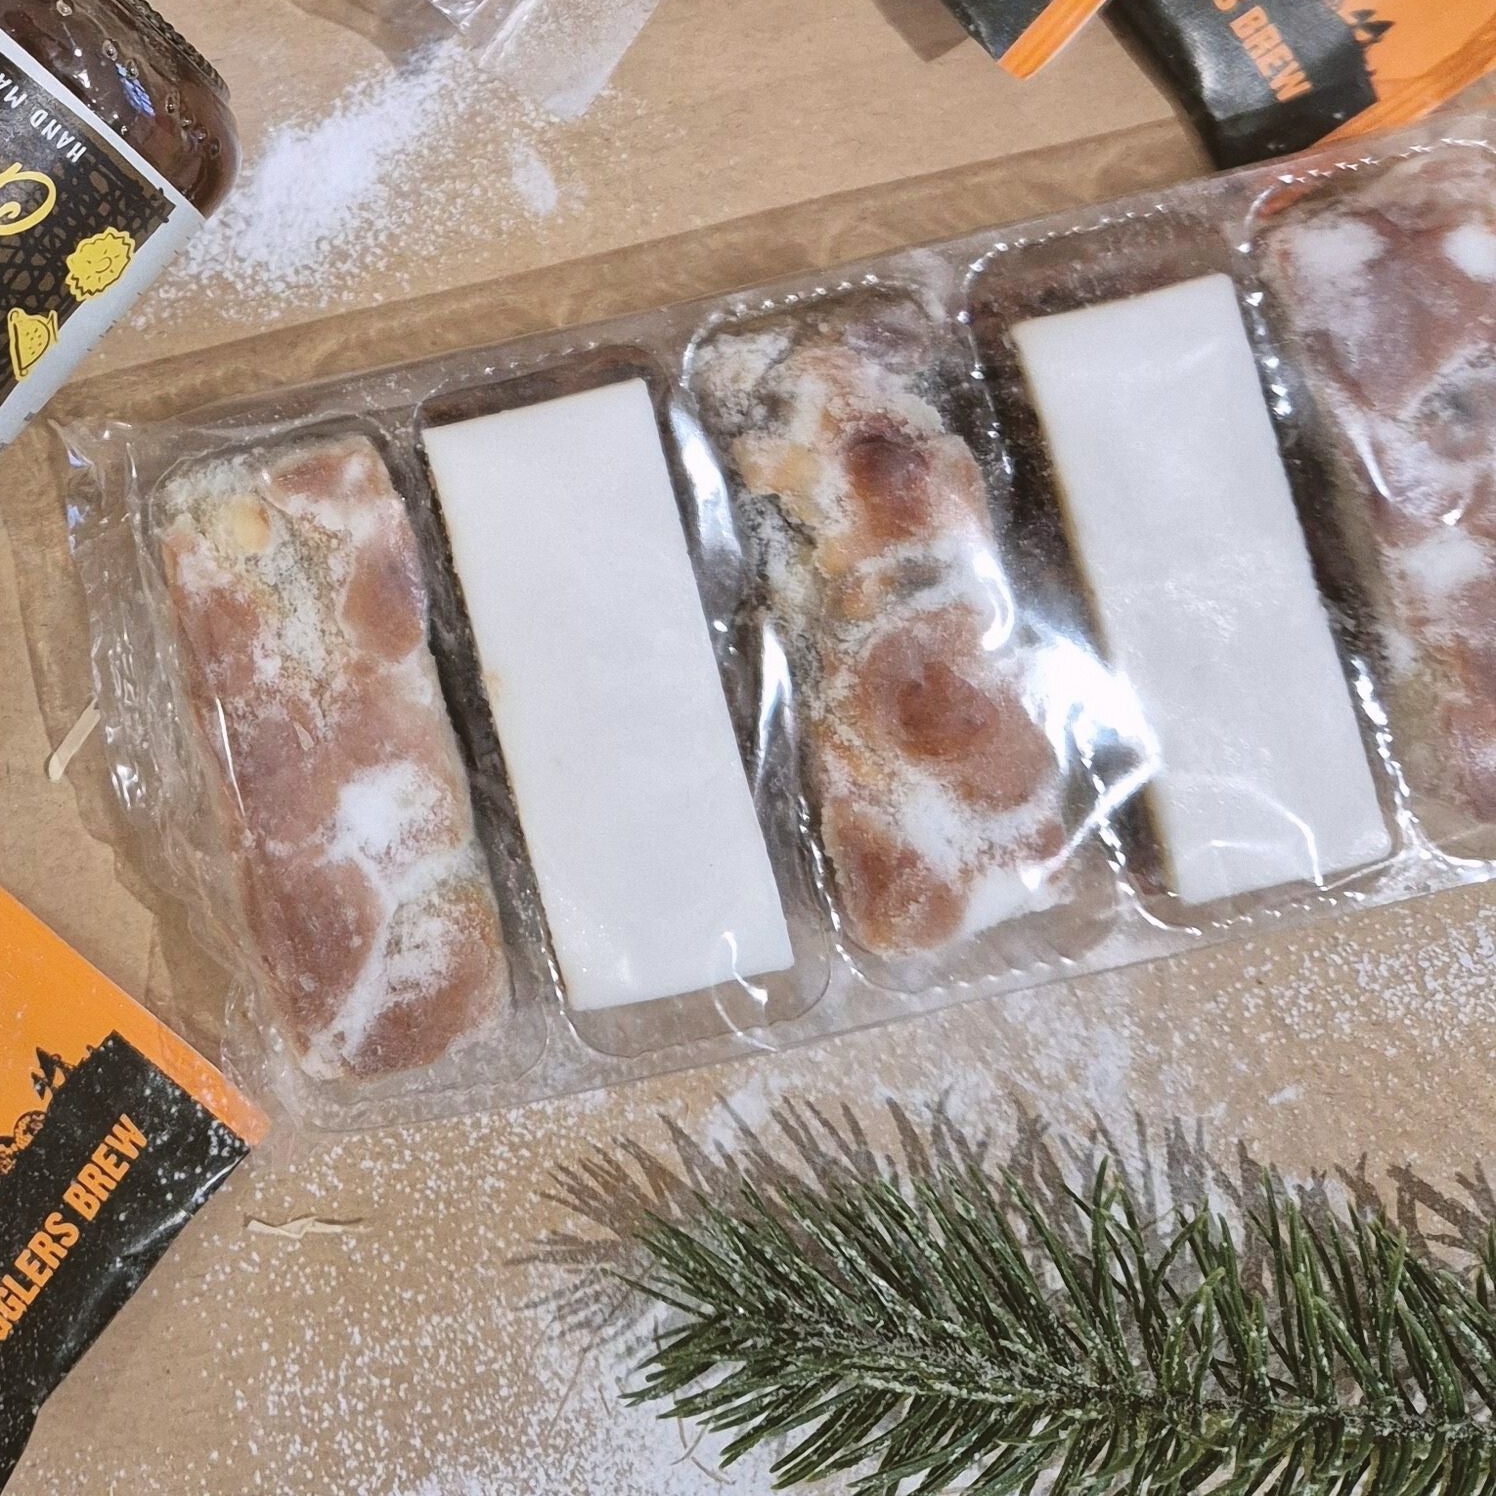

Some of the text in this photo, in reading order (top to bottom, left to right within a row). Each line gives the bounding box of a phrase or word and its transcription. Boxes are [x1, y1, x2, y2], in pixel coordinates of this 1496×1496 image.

[1229, 5, 1314, 103] BREW
[29, 108, 87, 164] HAND
[62, 1113, 149, 1222] BREW
